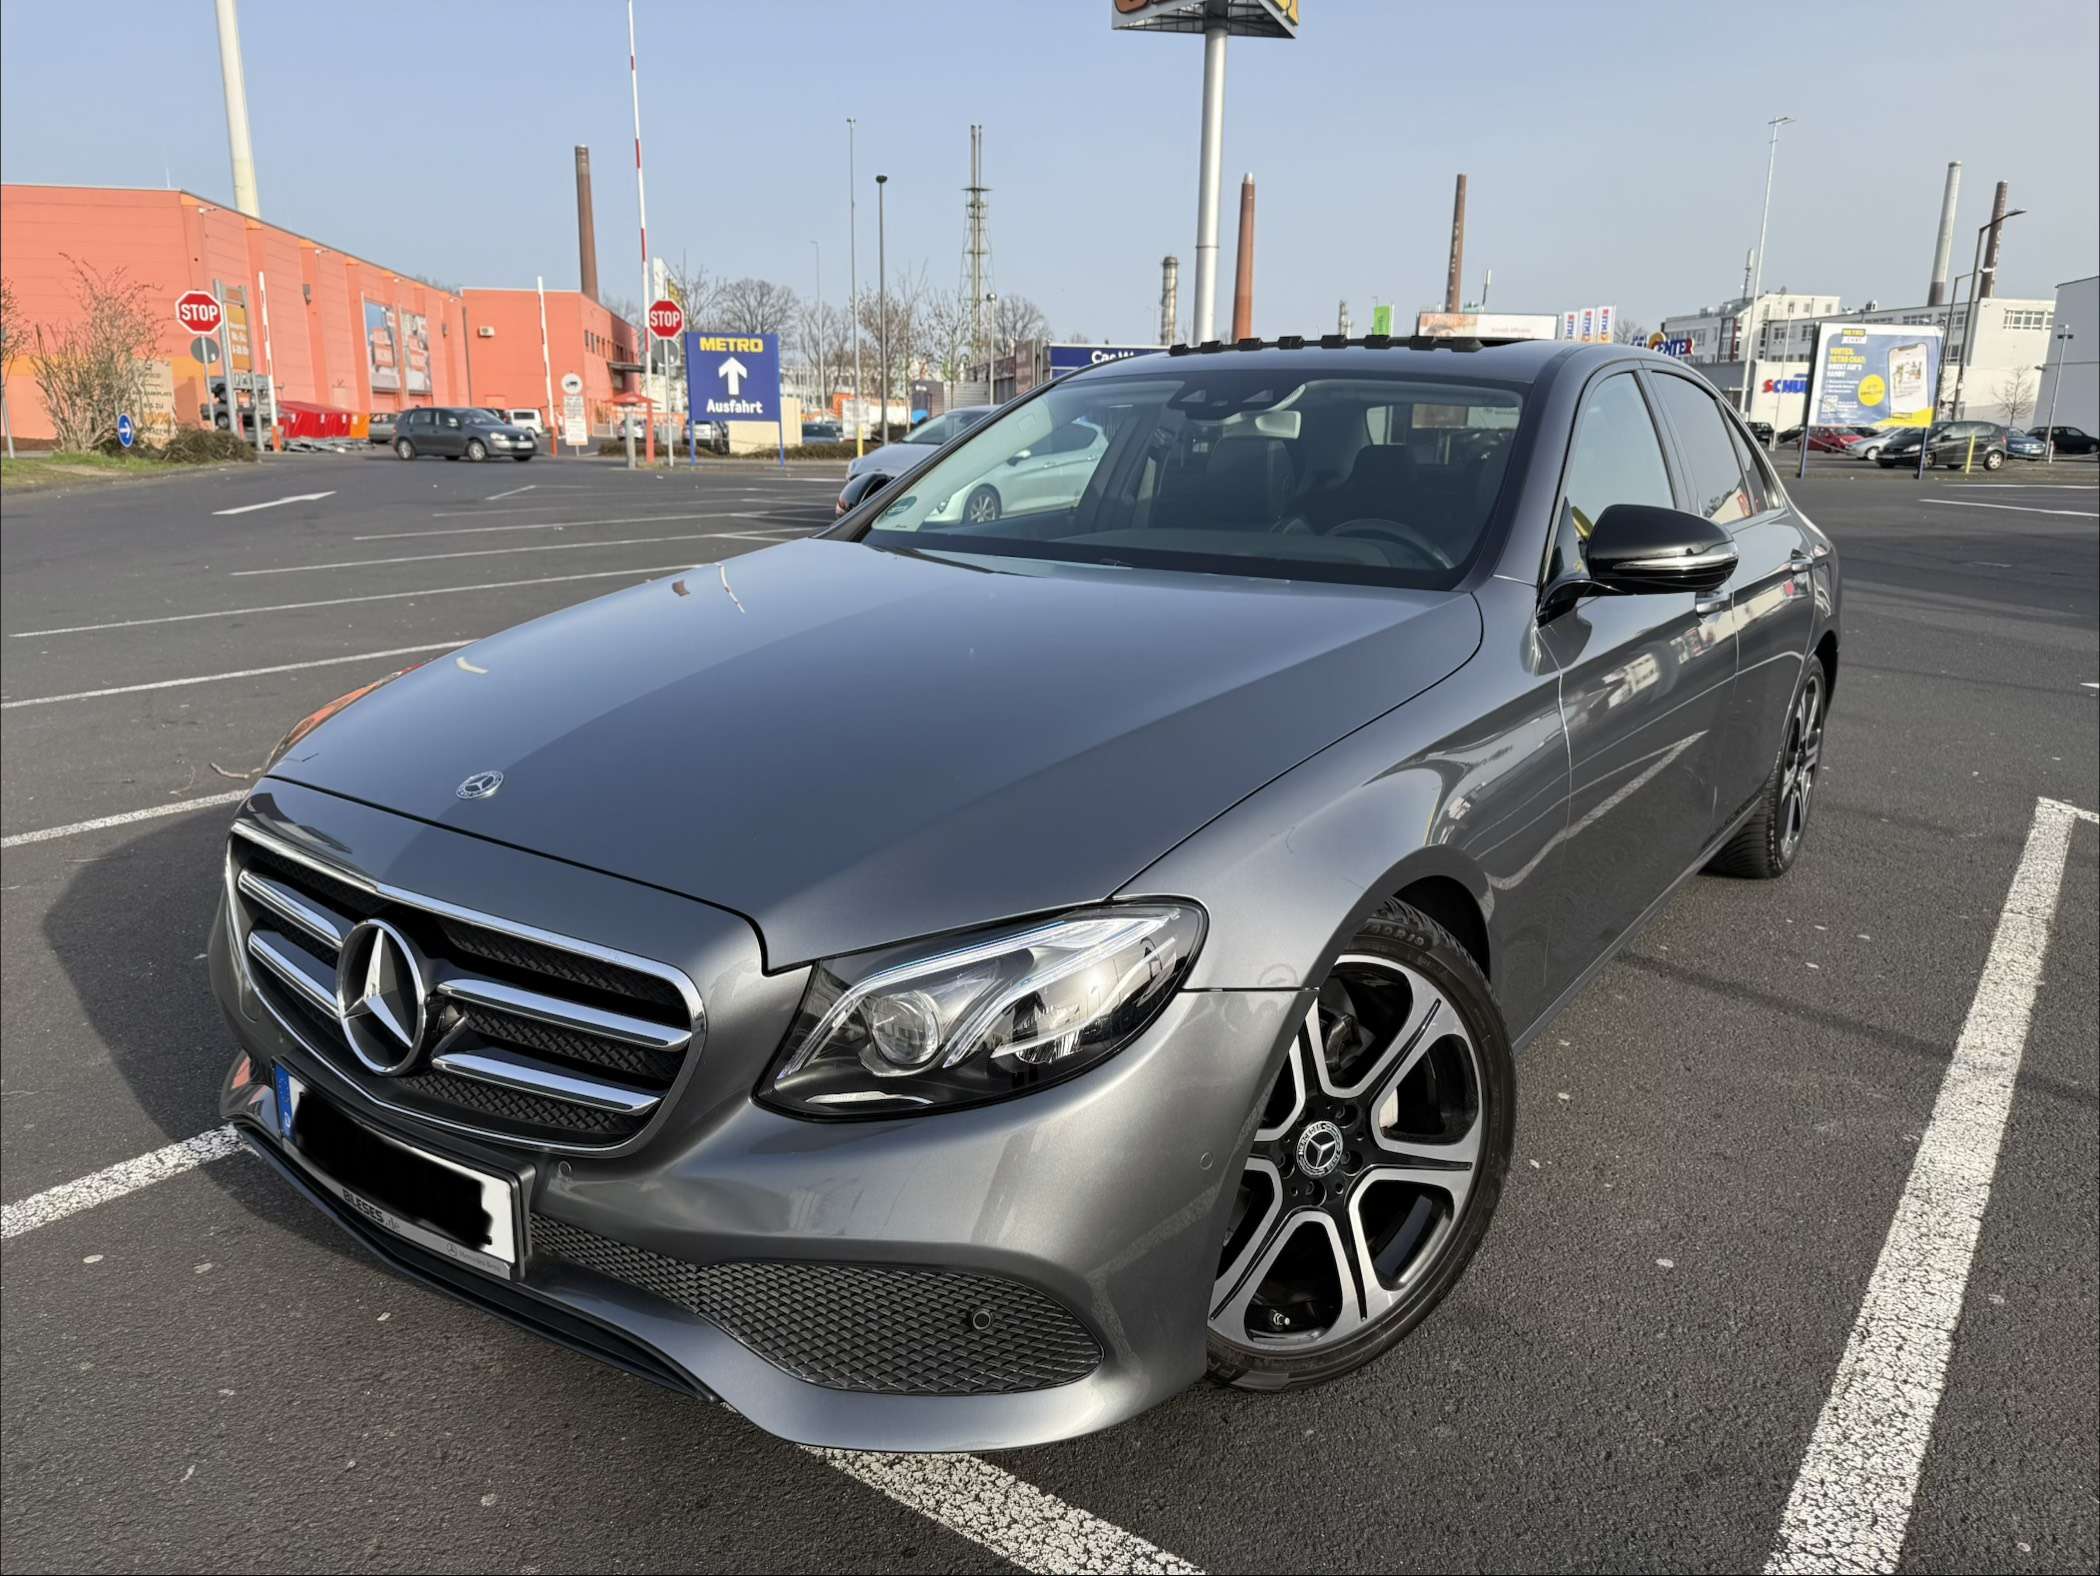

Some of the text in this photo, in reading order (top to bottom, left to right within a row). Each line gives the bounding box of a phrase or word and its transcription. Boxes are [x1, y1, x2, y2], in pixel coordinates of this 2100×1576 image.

[181, 304, 218, 322] STOP
[650, 310, 681, 328] STOP
[700, 337, 764, 353] METRO
[1762, 379, 1809, 394] SCHU
[707, 399, 764, 415] Ausfahrt
